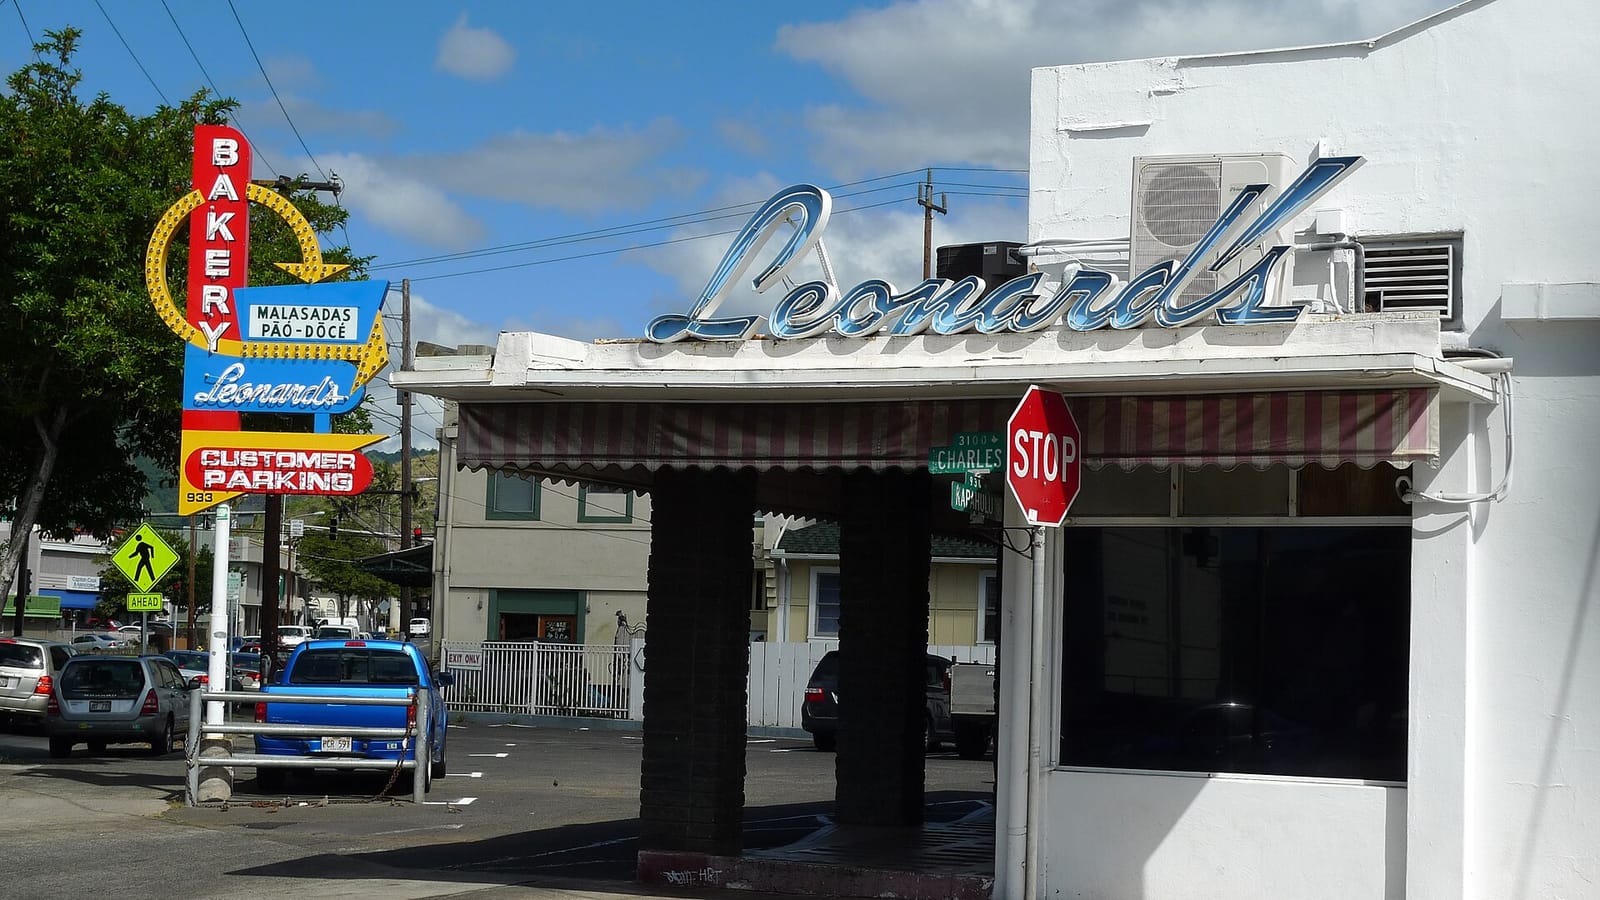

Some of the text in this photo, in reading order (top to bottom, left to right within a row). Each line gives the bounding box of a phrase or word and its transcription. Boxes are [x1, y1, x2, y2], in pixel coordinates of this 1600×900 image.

[198, 138, 239, 354] BAKERY
[257, 306, 351, 322] MALASADAS
[958, 435, 987, 446] 3100
[200, 449, 356, 471] CUSTOMER
[937, 448, 1003, 470] CHARLES
[1013, 428, 1077, 483] STOP
[203, 469, 354, 491] PARKING
[186, 492, 213, 503] 933
[131, 597, 158, 607] AHEAD
[448, 653, 480, 664] EXIT ONLY
